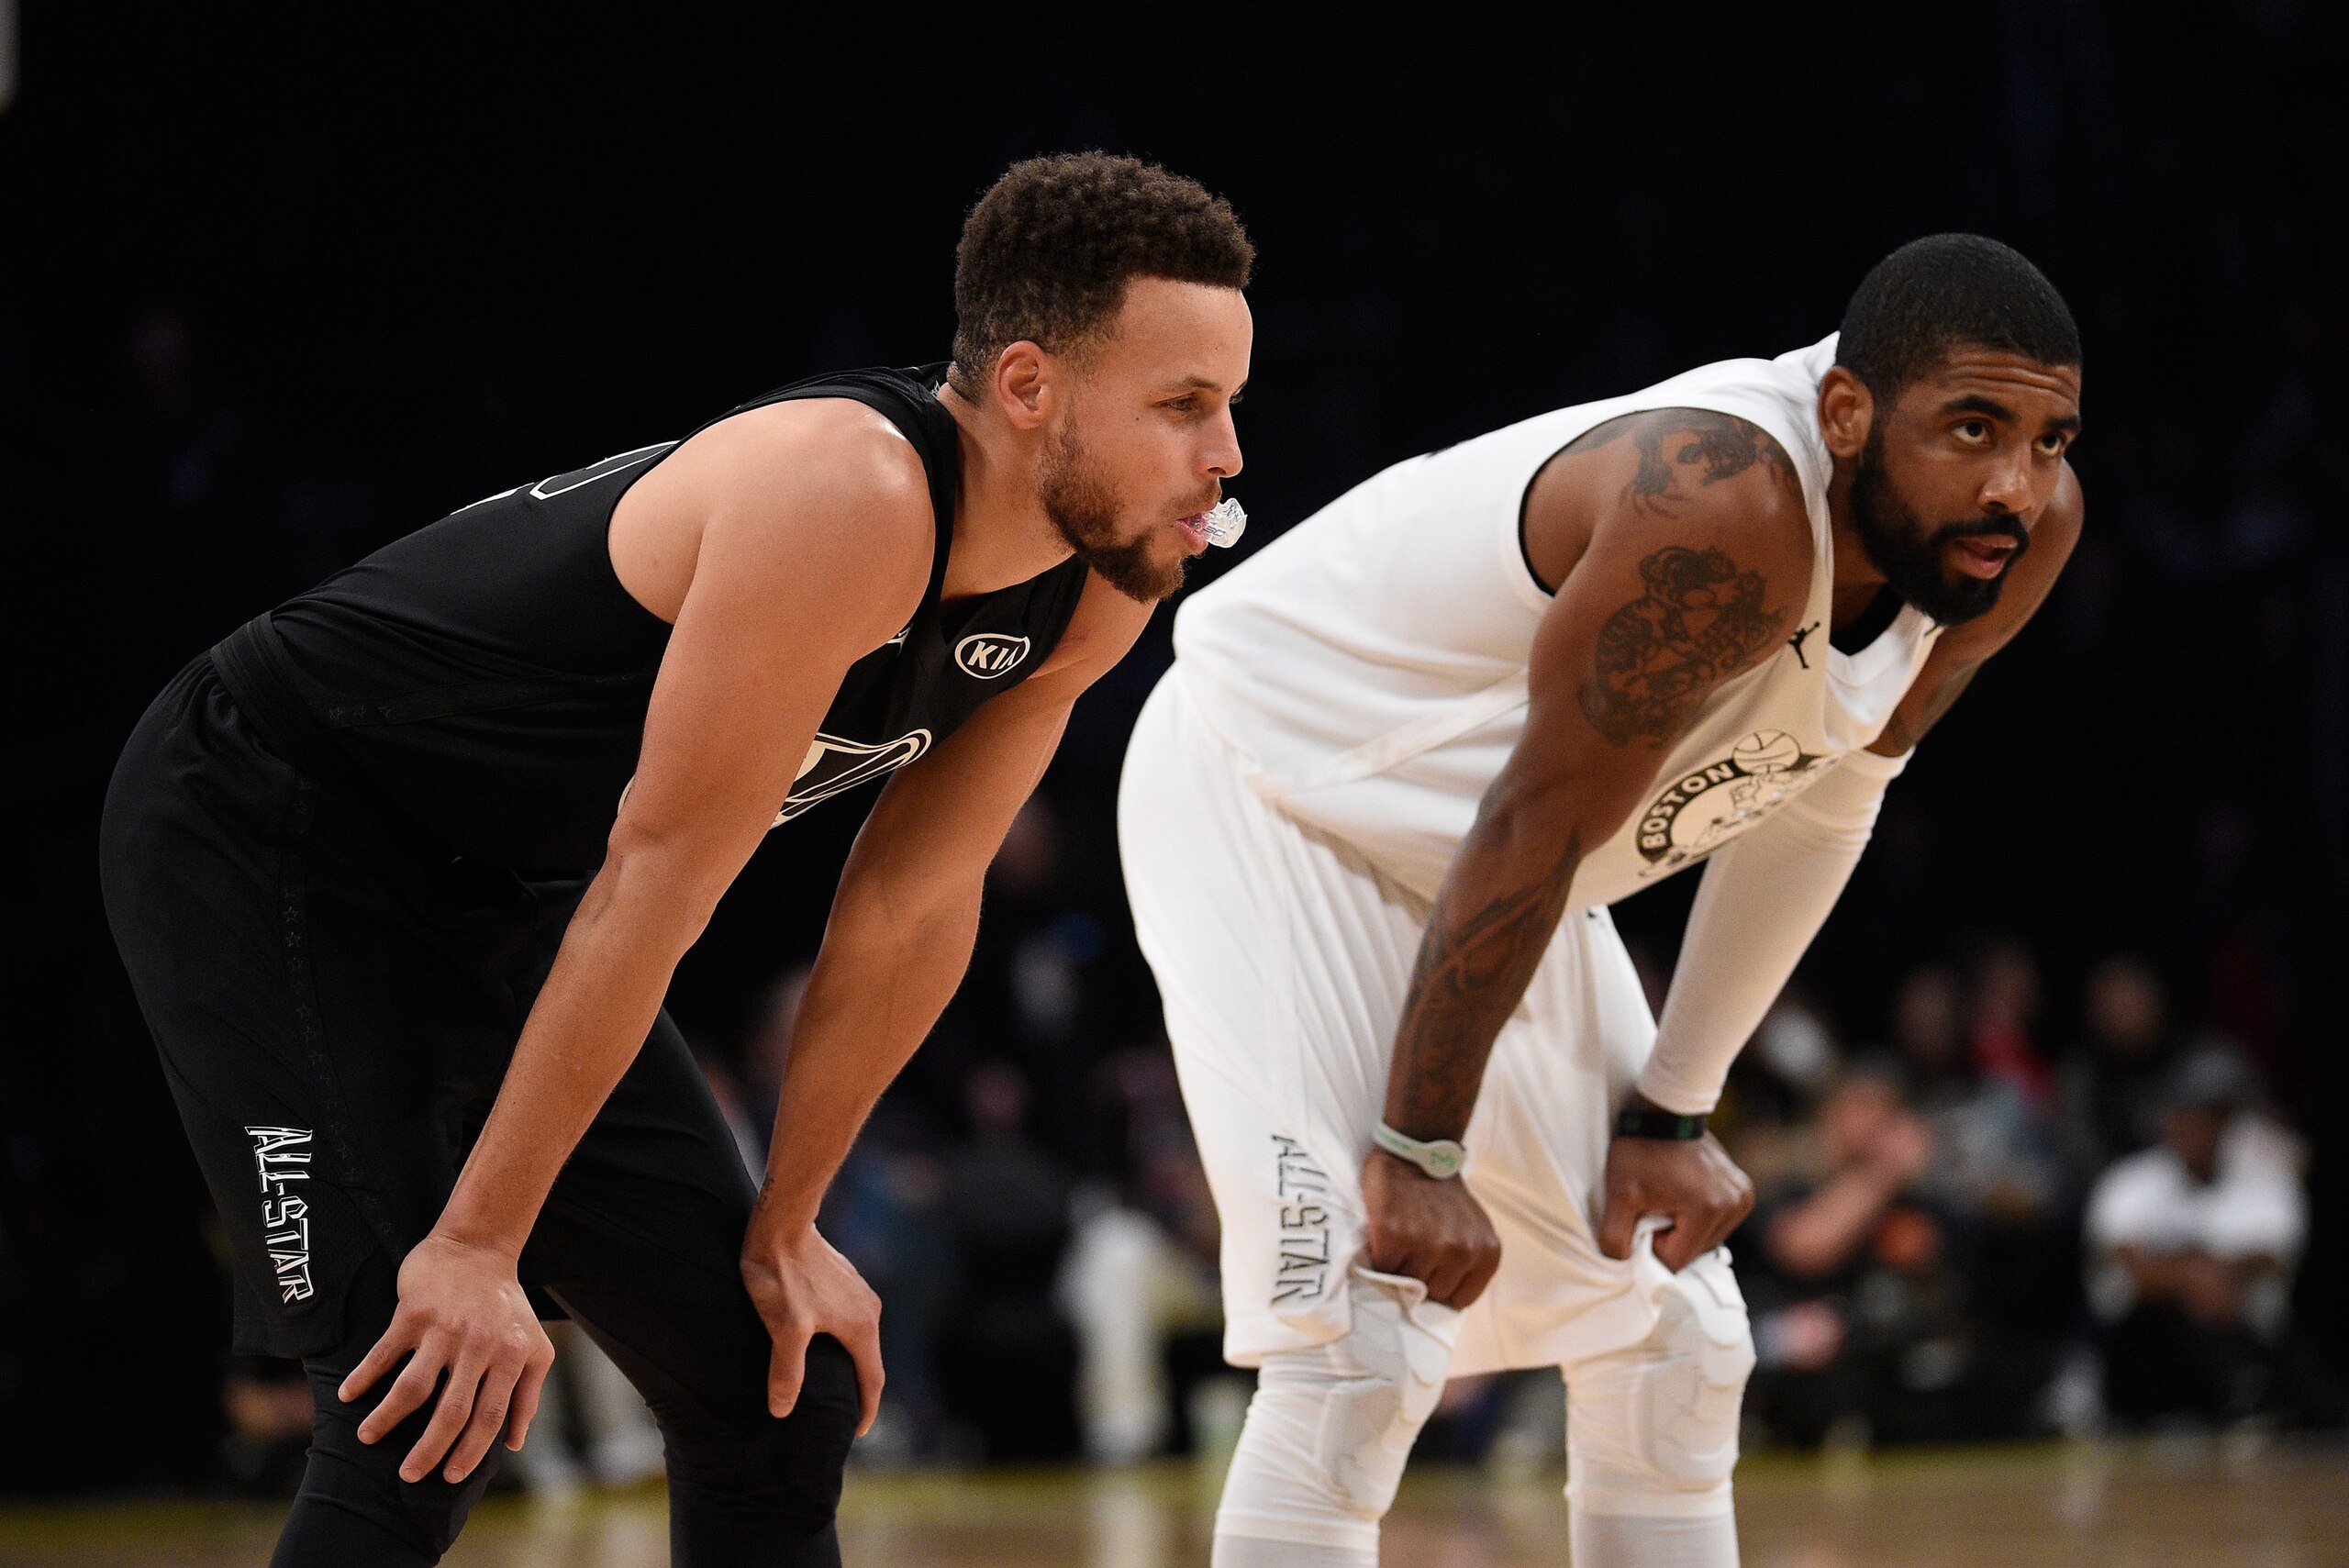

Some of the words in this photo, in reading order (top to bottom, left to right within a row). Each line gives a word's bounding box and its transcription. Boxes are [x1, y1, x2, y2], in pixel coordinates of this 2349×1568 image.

[965, 639, 1022, 672] KIA
[1642, 762, 1735, 850] BOSTON
[243, 1125, 314, 1304] ALL-STAR
